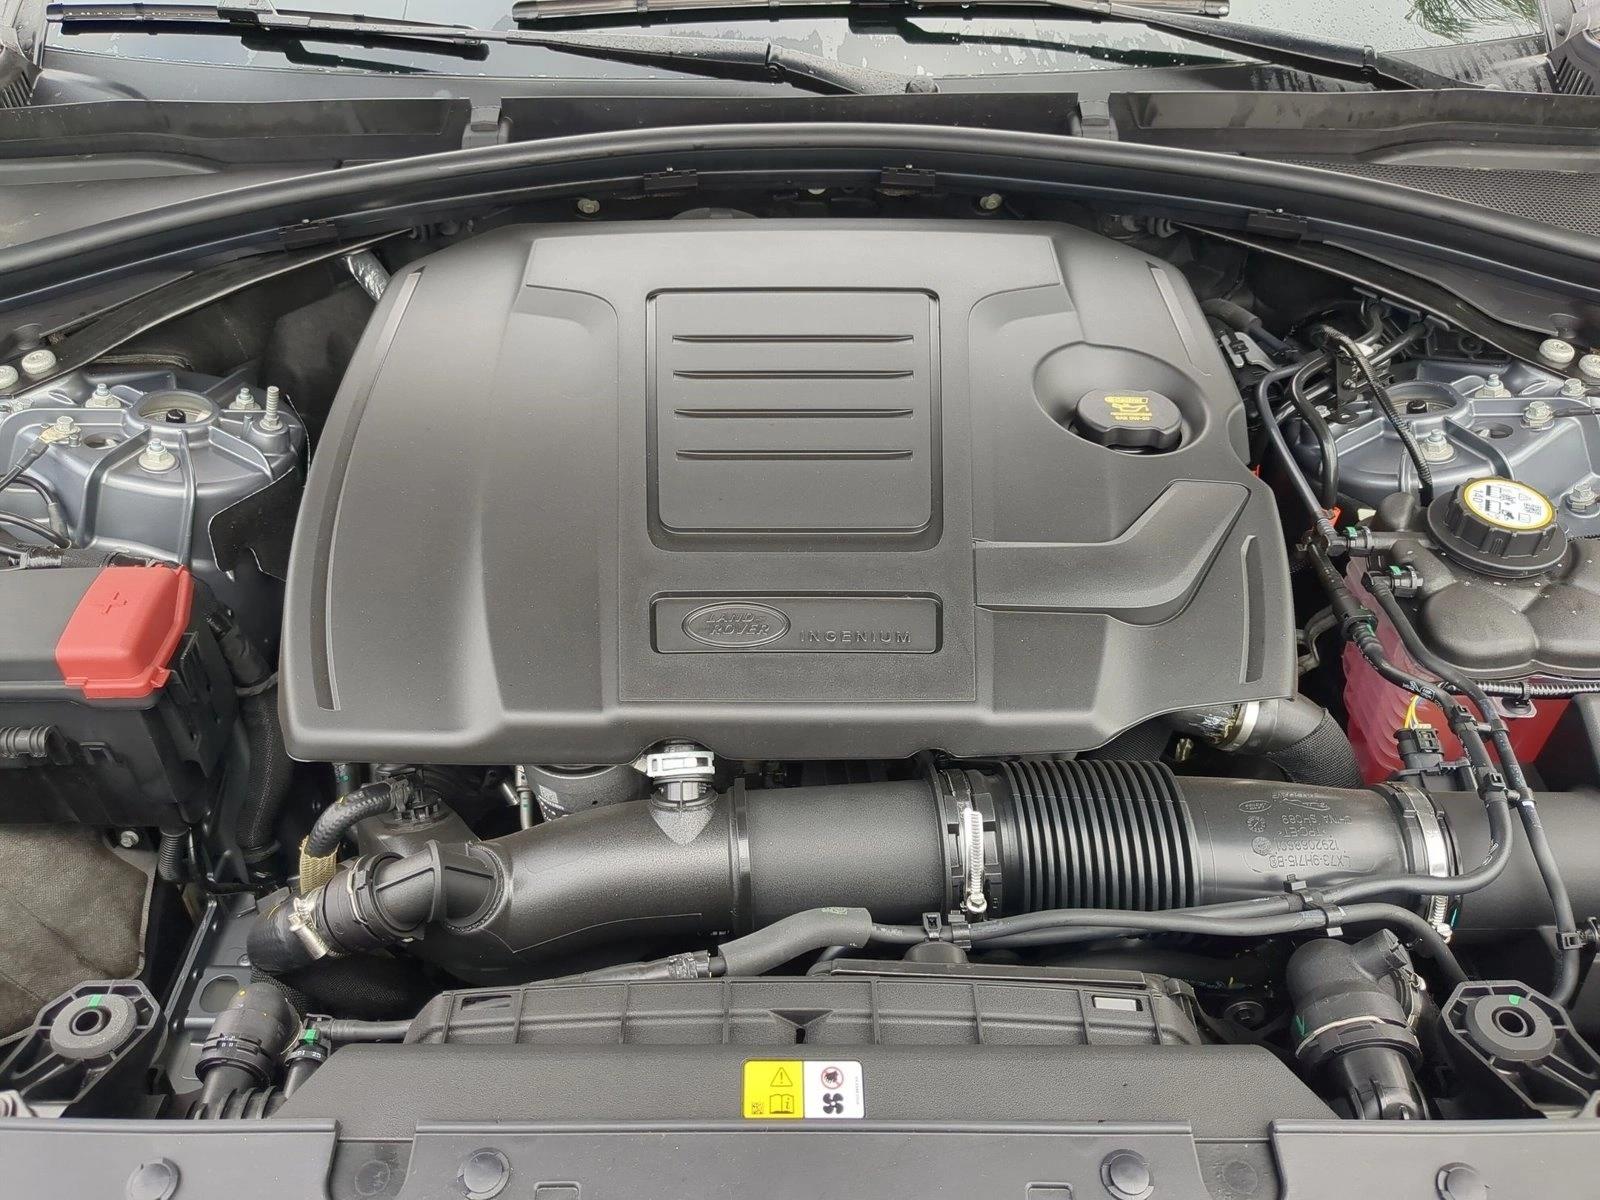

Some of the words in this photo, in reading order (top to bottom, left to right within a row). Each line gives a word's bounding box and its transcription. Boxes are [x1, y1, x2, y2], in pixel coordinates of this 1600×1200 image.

[706, 612, 756, 624] LAND
[709, 623, 771, 636] ROVER
[800, 630, 912, 644] INGENIUM
